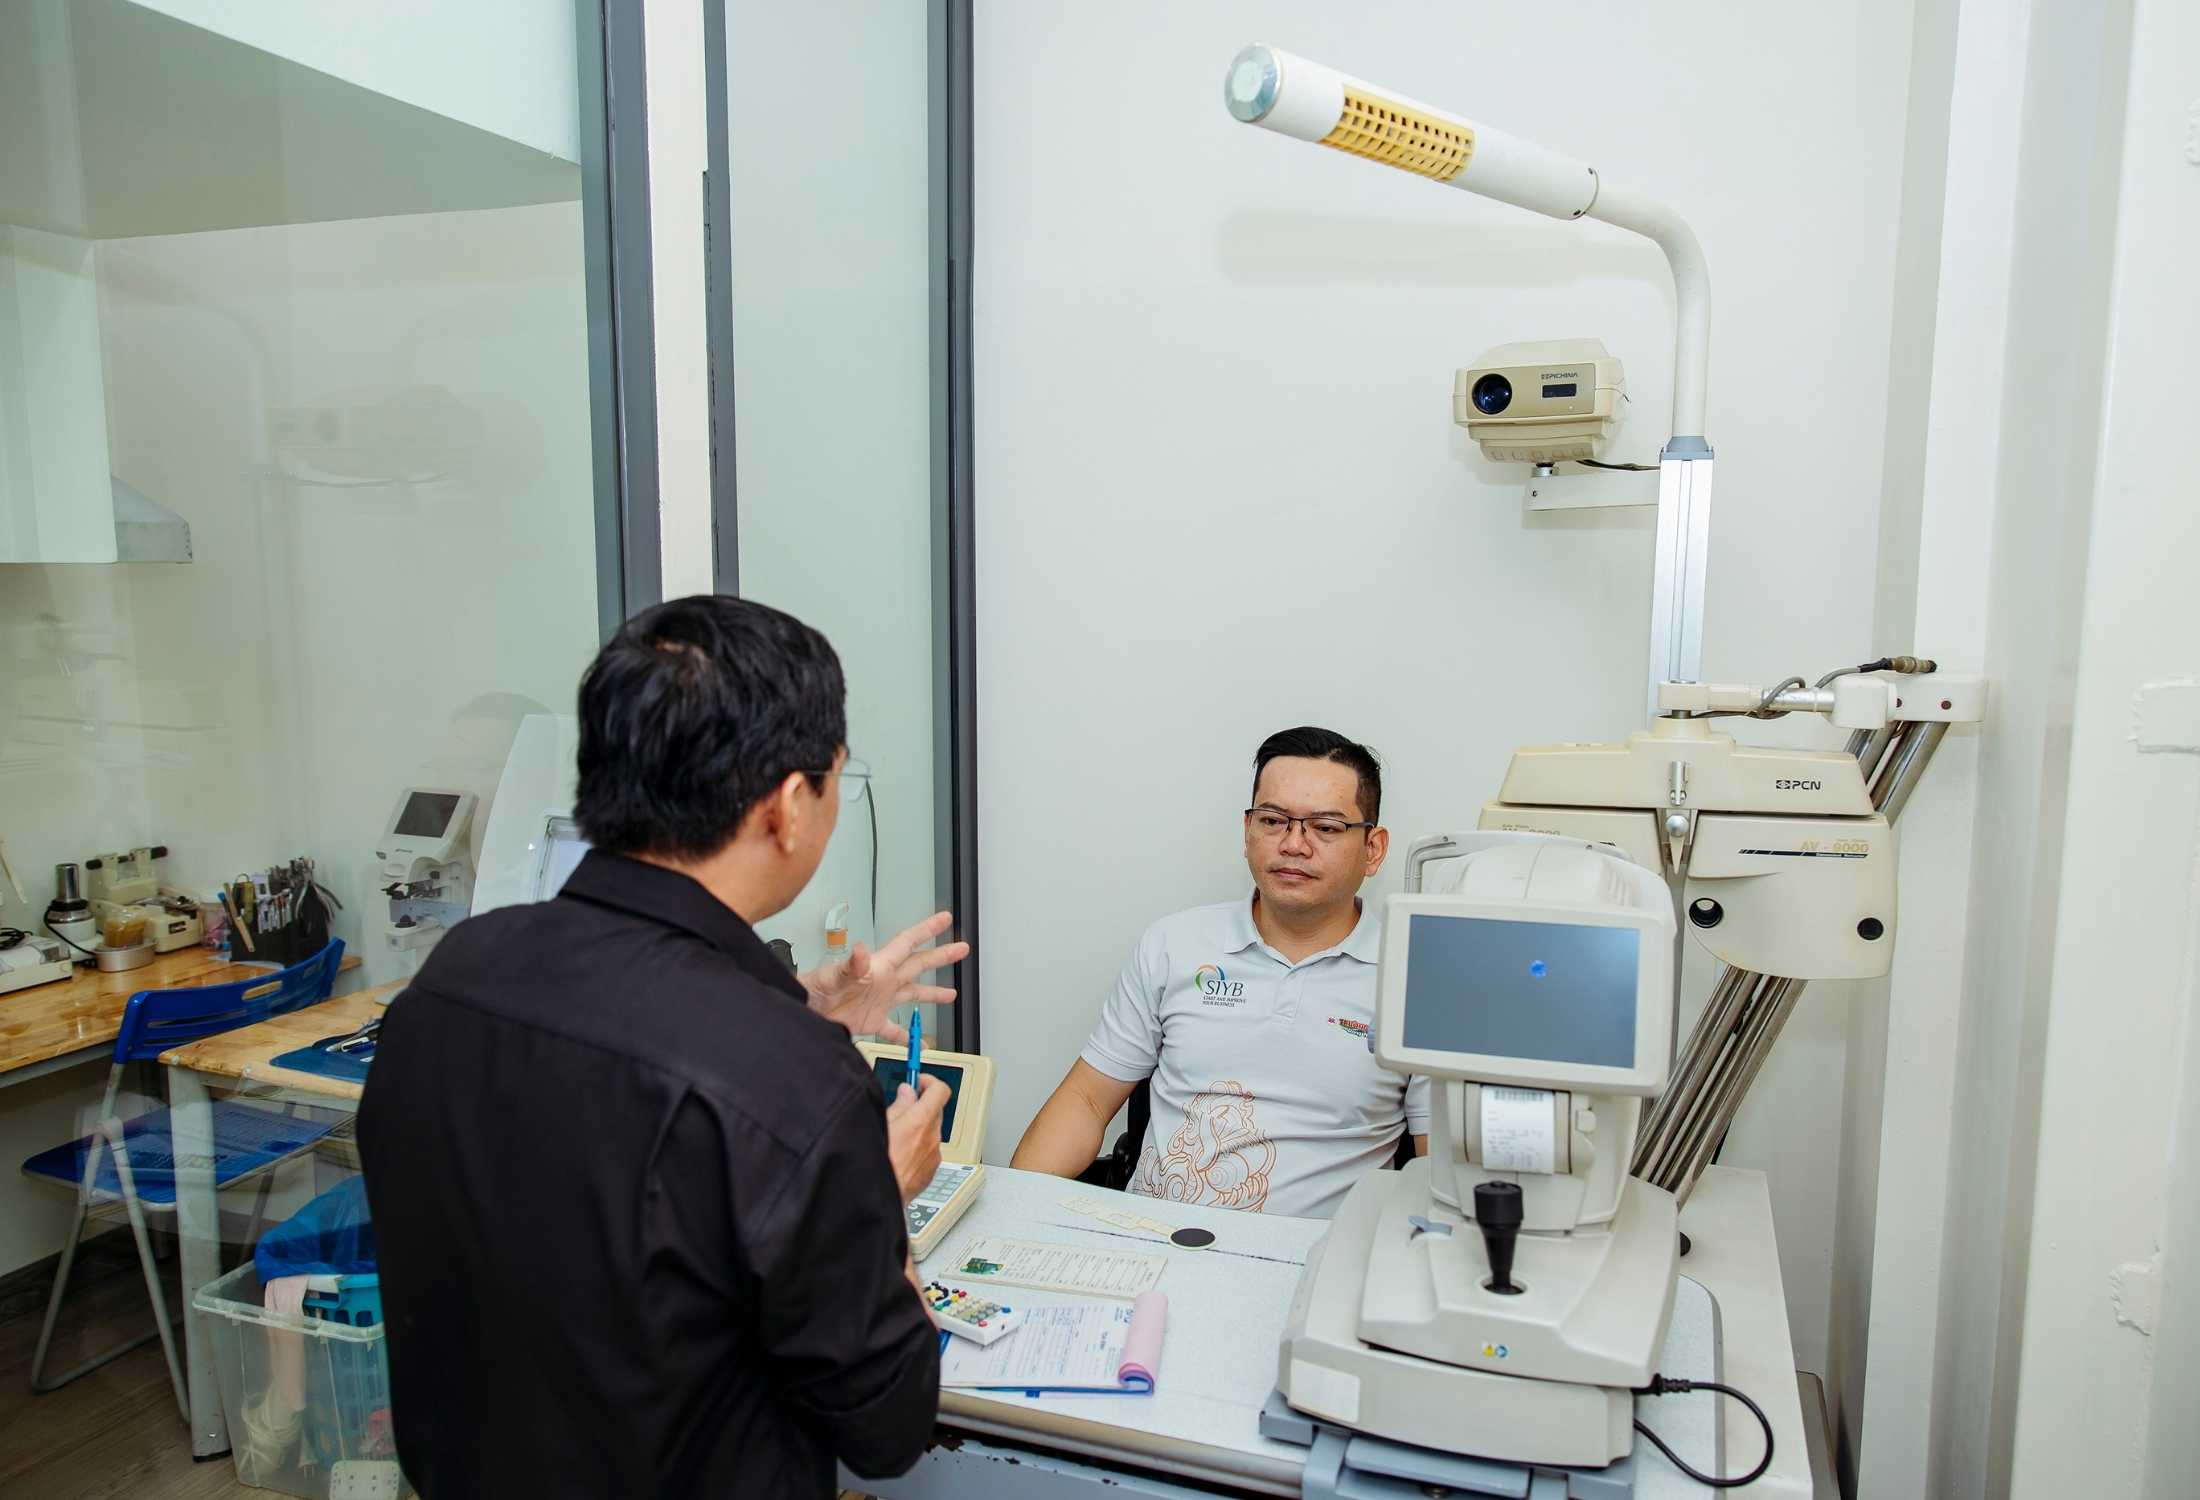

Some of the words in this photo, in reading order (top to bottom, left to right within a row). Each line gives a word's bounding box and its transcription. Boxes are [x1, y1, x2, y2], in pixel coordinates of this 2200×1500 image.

[1792, 780, 1821, 790] PCN
[1800, 841, 1819, 851] AV
[1833, 842, 1869, 853] 9000
[1205, 980, 1243, 997] SIYB
